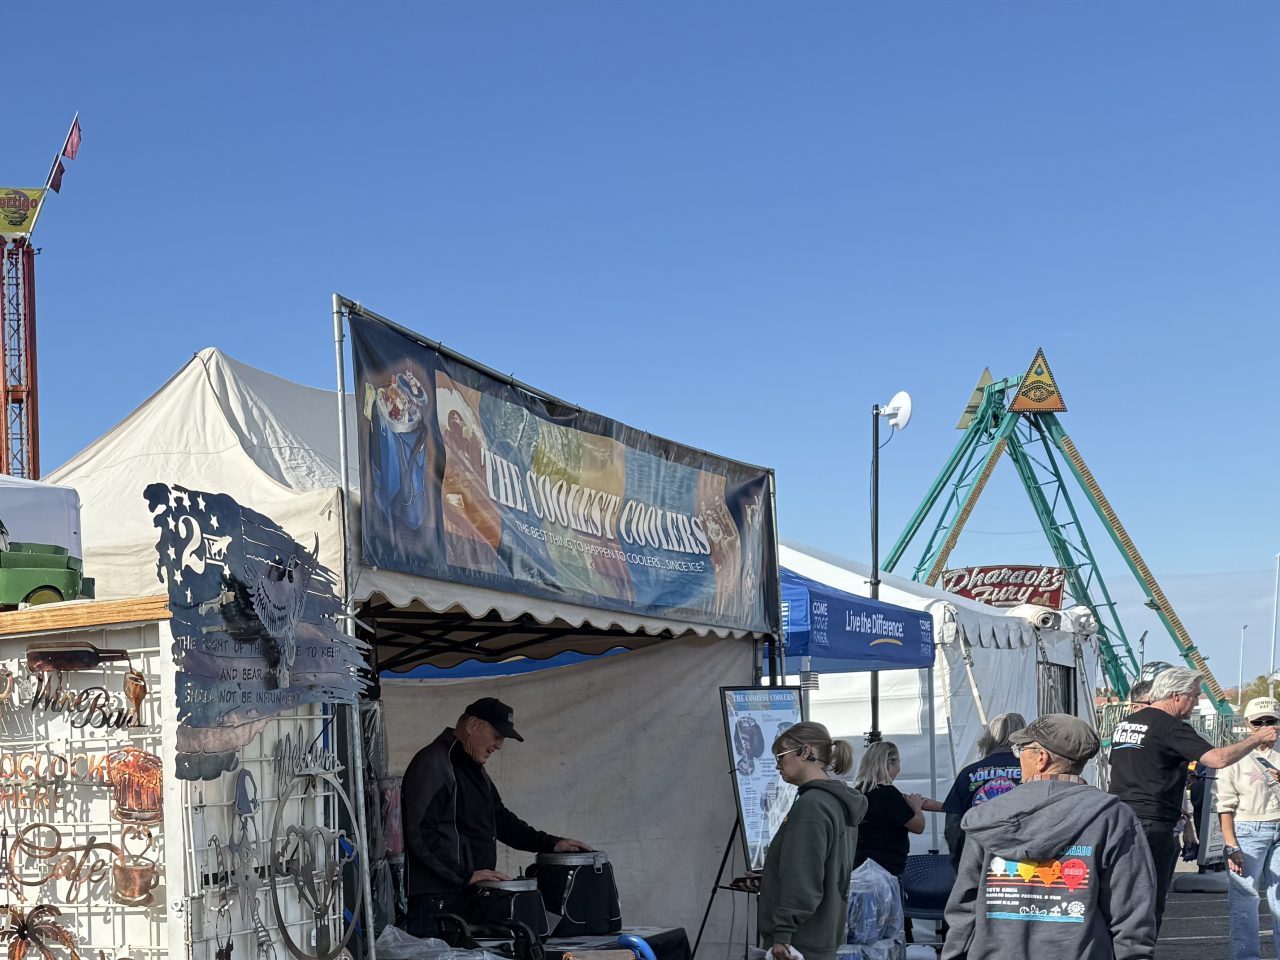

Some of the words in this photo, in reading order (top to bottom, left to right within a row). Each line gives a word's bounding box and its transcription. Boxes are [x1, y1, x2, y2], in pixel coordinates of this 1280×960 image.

[480, 449, 528, 513] THE
[526, 469, 620, 541] COOLEST
[619, 499, 712, 555] COOLERS
[530, 526, 548, 542] BEST
[548, 532, 572, 548] THING
[570, 539, 584, 552] TO
[584, 543, 616, 561] HAPPEN
[615, 550, 626, 562] TO
[665, 559, 689, 572] SINCE
[943, 566, 1064, 594] Pharaoh's
[971, 585, 1035, 605] Fury
[813, 602, 829, 616] COME
[845, 610, 861, 633] Live
[860, 611, 871, 634] the
[176, 636, 197, 650] THE
[234, 639, 244, 654] OF
[306, 646, 318, 658] TO
[221, 668, 239, 682] AND
[241, 668, 264, 681] BEAR
[220, 690, 236, 703] NOT
[241, 691, 252, 704] BE
[1112, 730, 1146, 745] Maker
[968, 768, 1022, 783] VOLUNTE
